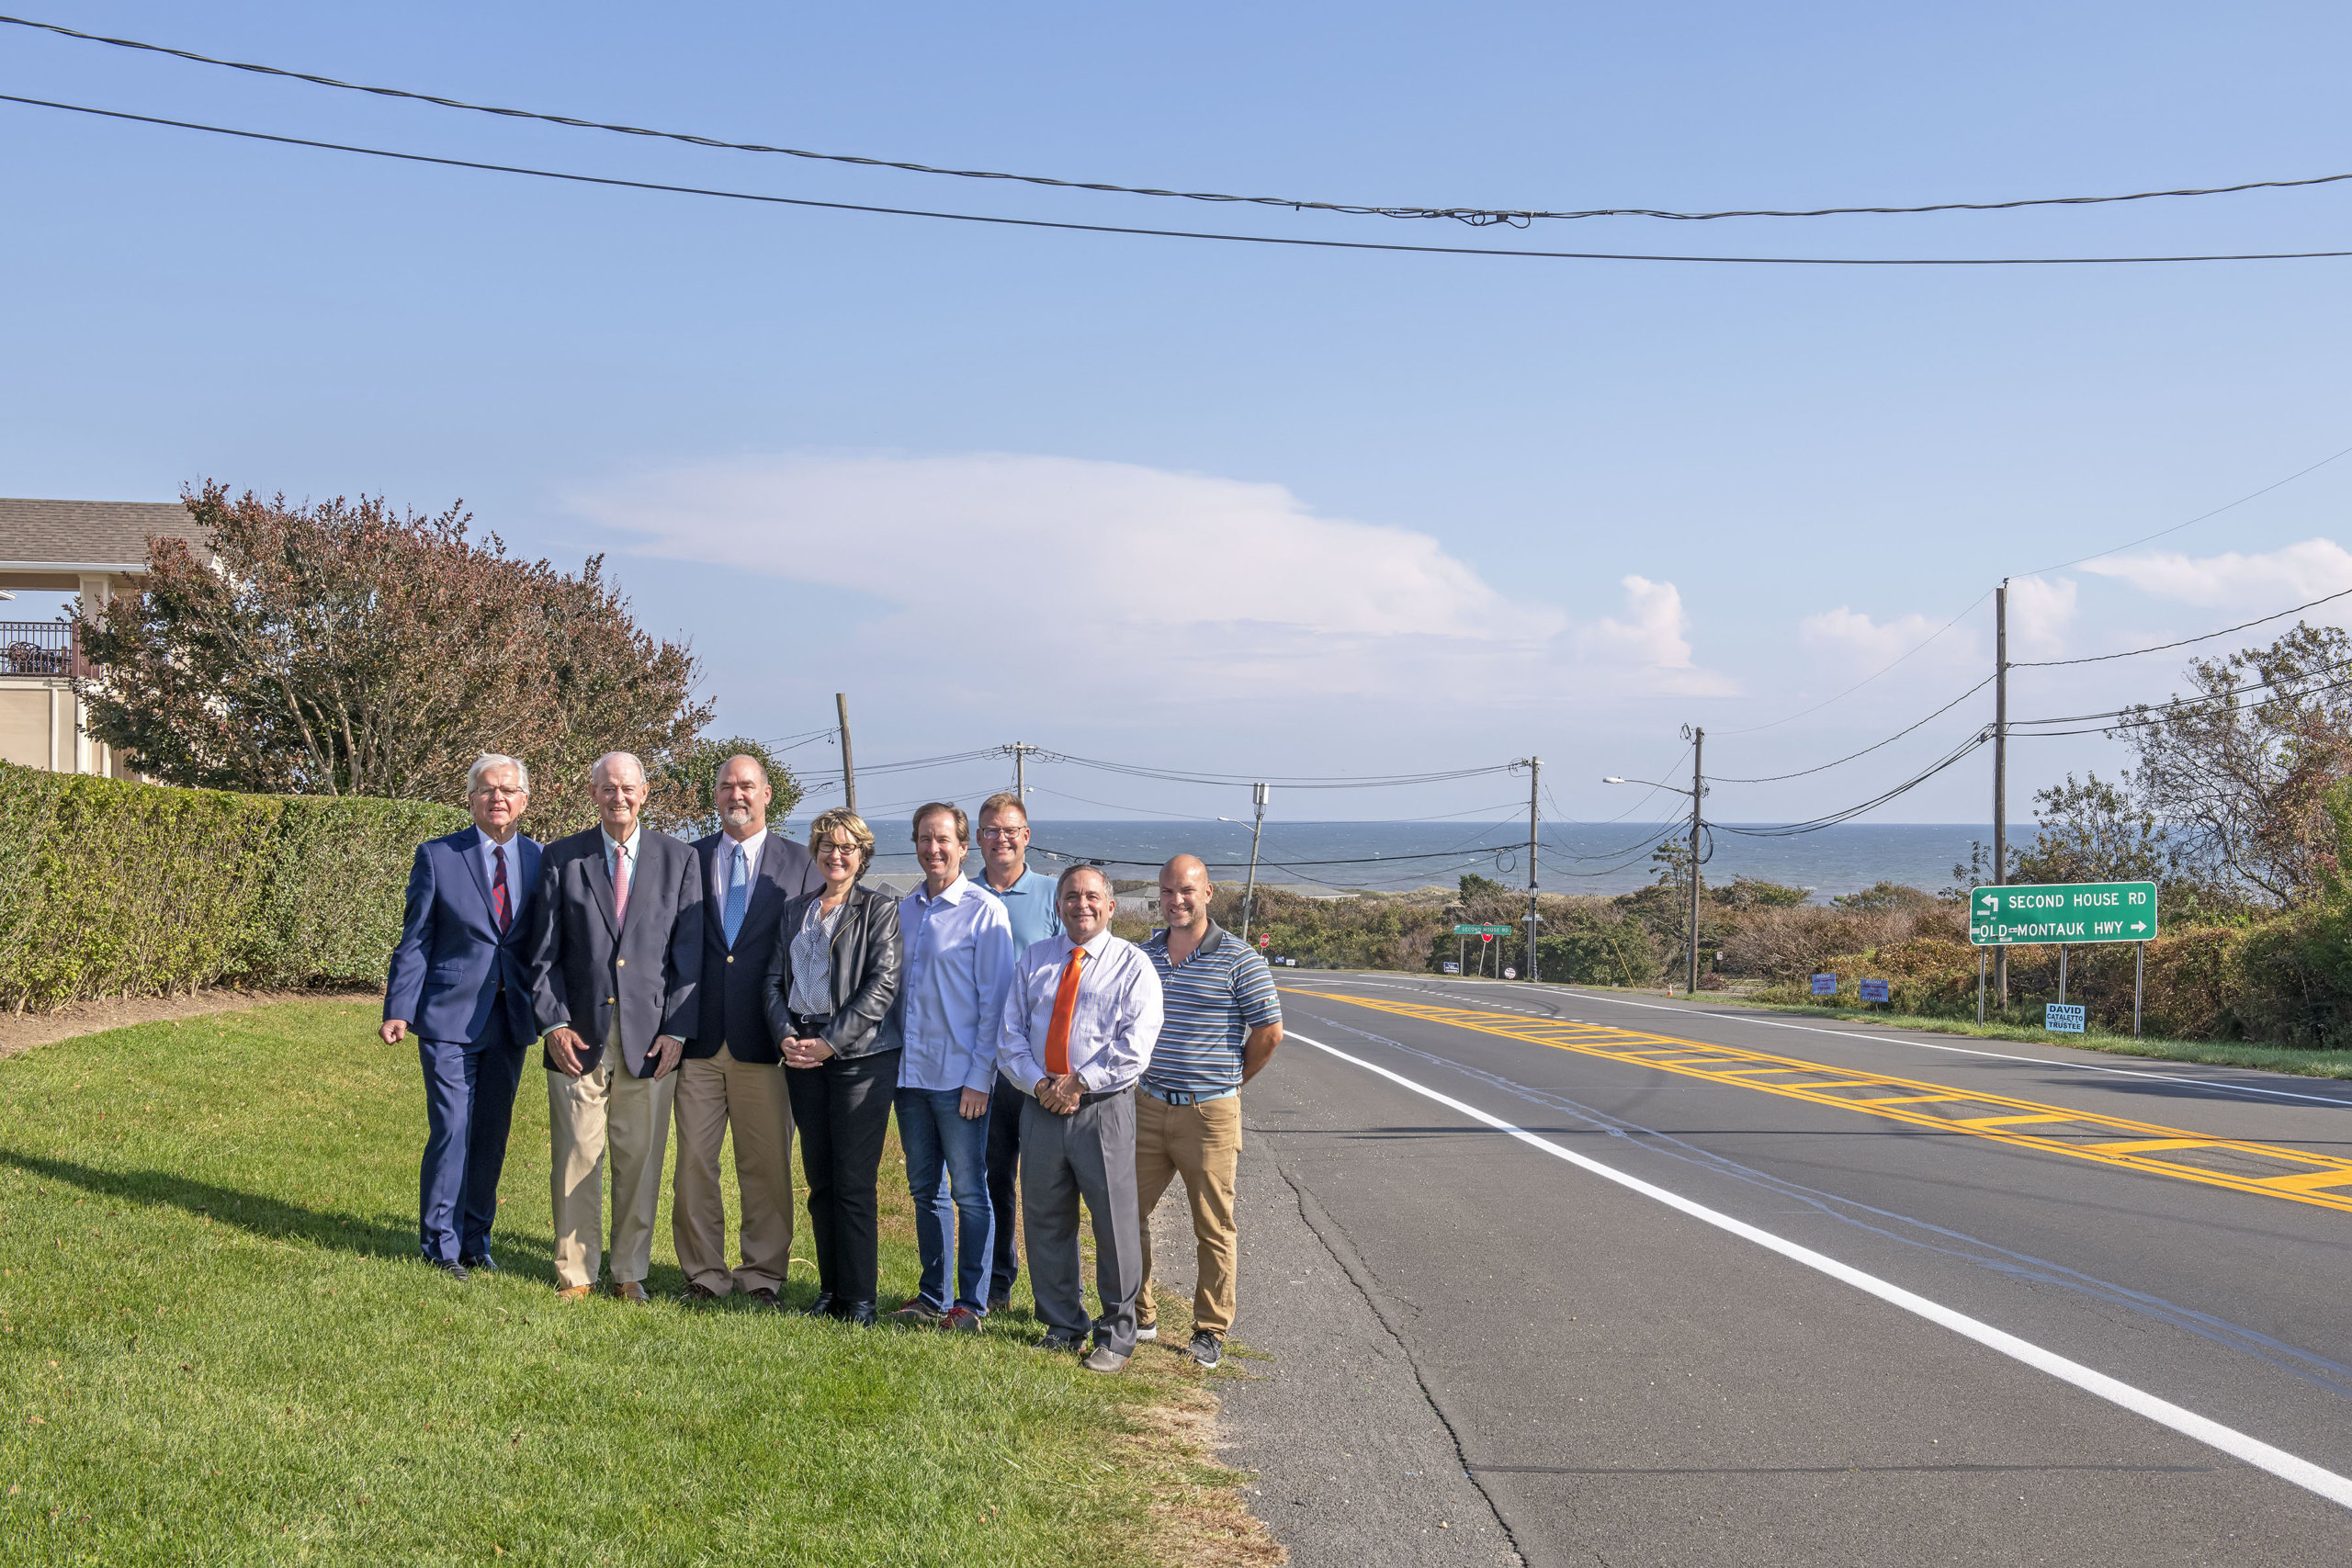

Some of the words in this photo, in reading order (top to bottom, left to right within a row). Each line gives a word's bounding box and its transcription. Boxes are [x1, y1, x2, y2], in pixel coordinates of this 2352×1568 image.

[2008, 895, 2064, 908] SECOND
[2074, 893, 2120, 907] HOUSE
[2129, 892, 2146, 905] RD
[1980, 924, 2007, 938] OLD
[2017, 922, 2085, 936] MONTAUK
[2095, 921, 2123, 935] HWY
[2050, 1006, 2081, 1014] DAVID
[2047, 1013, 2083, 1021] CATALETTO
[2049, 1021, 2081, 1030] TRUSTEE
